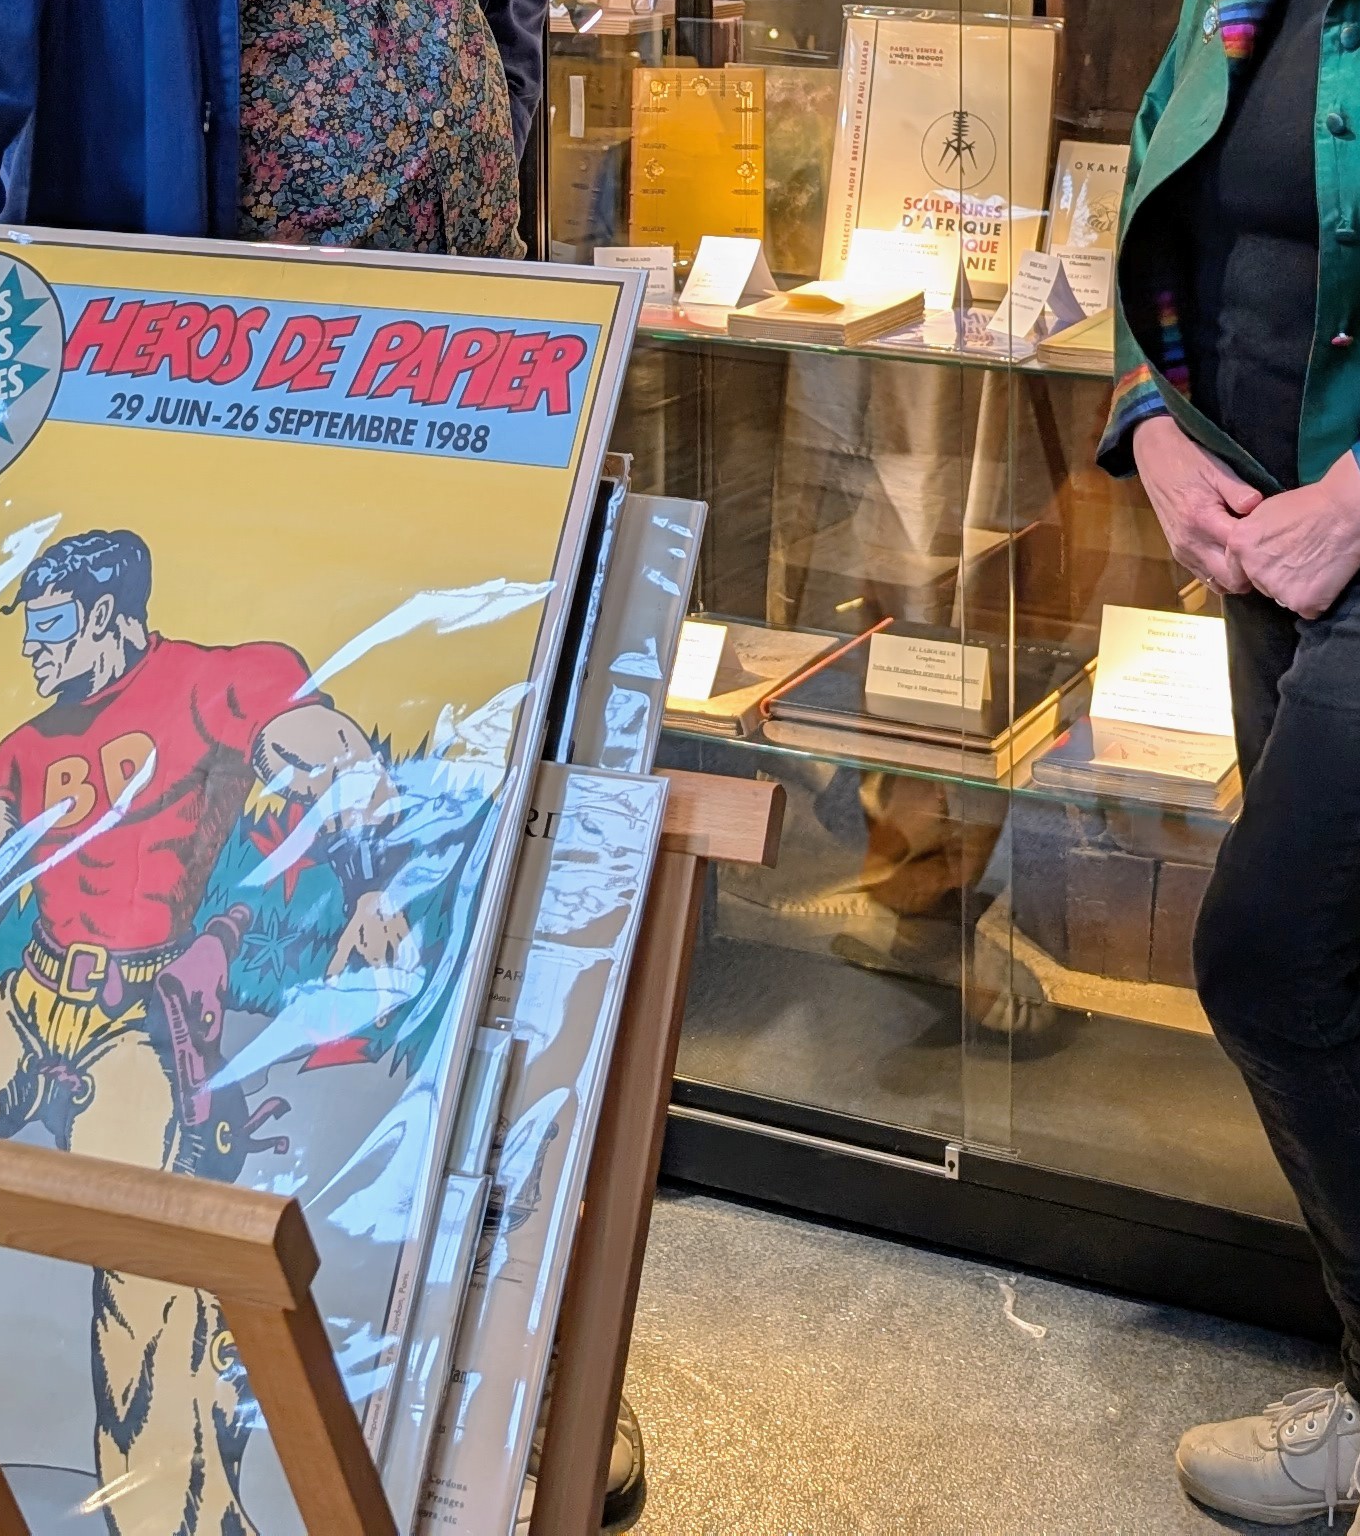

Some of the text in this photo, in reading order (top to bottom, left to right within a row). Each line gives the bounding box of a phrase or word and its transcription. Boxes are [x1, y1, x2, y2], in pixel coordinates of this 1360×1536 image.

[841, 40, 869, 261] COLLECTION ANDRÉ BRETON ET PAUL ELUARD
[904, 197, 1002, 219] SCULPTURES
[60, 297, 587, 416] HEROS DE PAPIER
[106, 393, 143, 421] 29
[264, 407, 418, 447] SEPTEMBRE
[425, 421, 490, 453] 1988
[44, 730, 157, 829] BD
